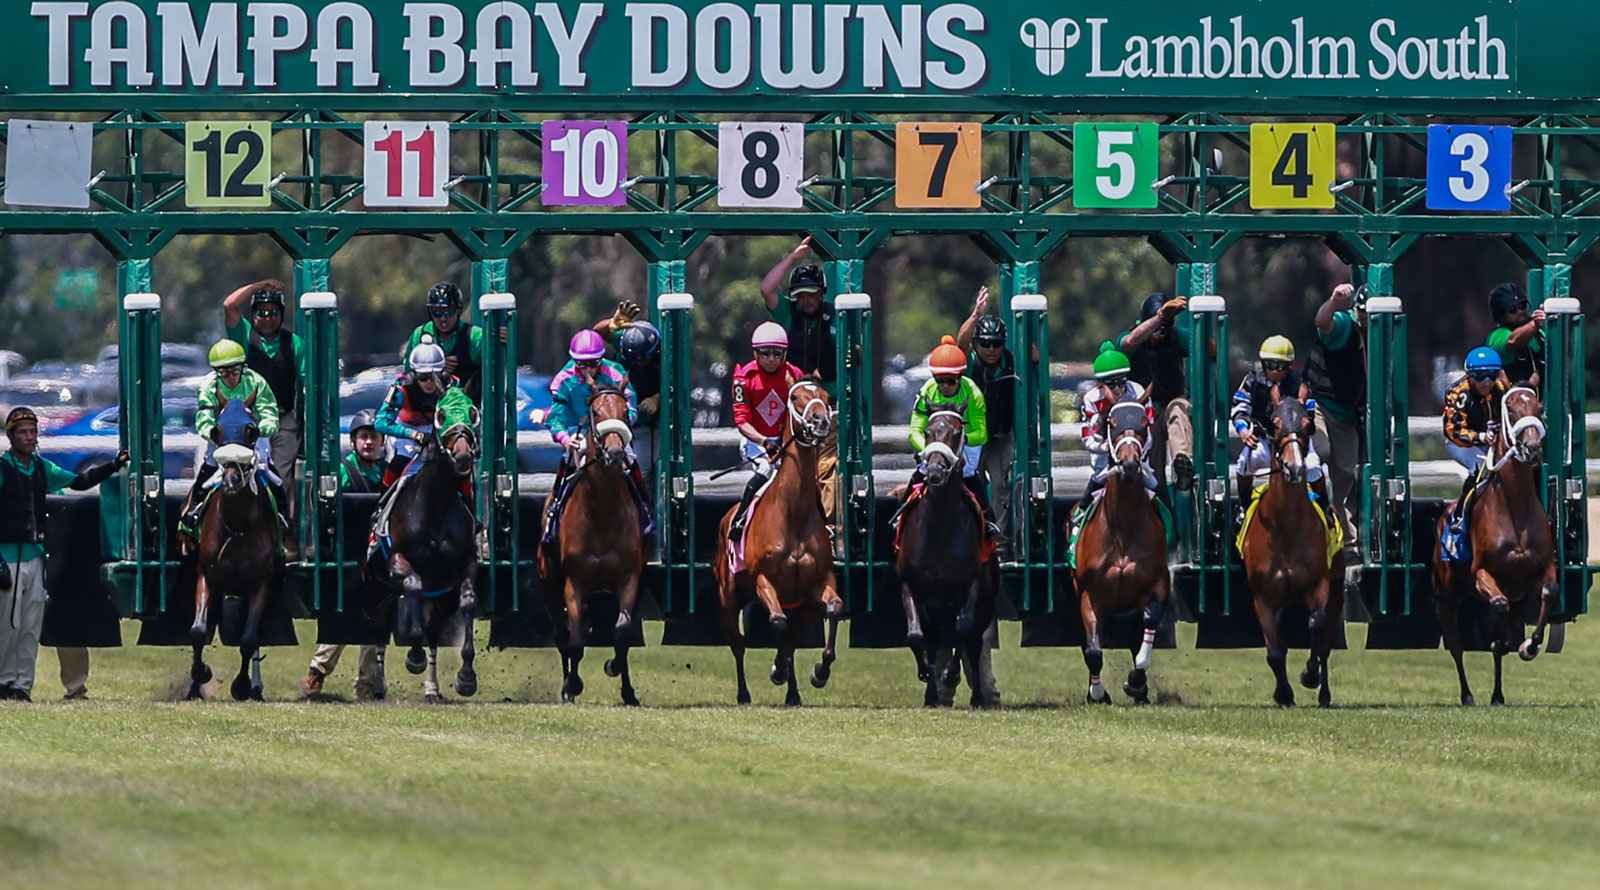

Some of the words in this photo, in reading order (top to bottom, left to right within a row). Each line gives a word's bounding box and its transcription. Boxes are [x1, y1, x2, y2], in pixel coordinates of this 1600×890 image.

[30, 1, 380, 88] TAMPA
[402, 1, 604, 88] BAY
[624, 2, 988, 90] DOWNS
[1085, 15, 1361, 80] Lambholm
[1368, 15, 1510, 81] South
[192, 130, 264, 198] 12
[375, 130, 434, 198] 11
[550, 128, 619, 198] 10
[741, 131, 780, 199] 8
[918, 132, 958, 198] 7
[1095, 131, 1135, 199] 5
[1271, 132, 1314, 199] 4
[1448, 133, 1490, 202] 3
[735, 386, 743, 402] 8
[768, 401, 778, 416] P
[1456, 392, 1468, 409] 3
